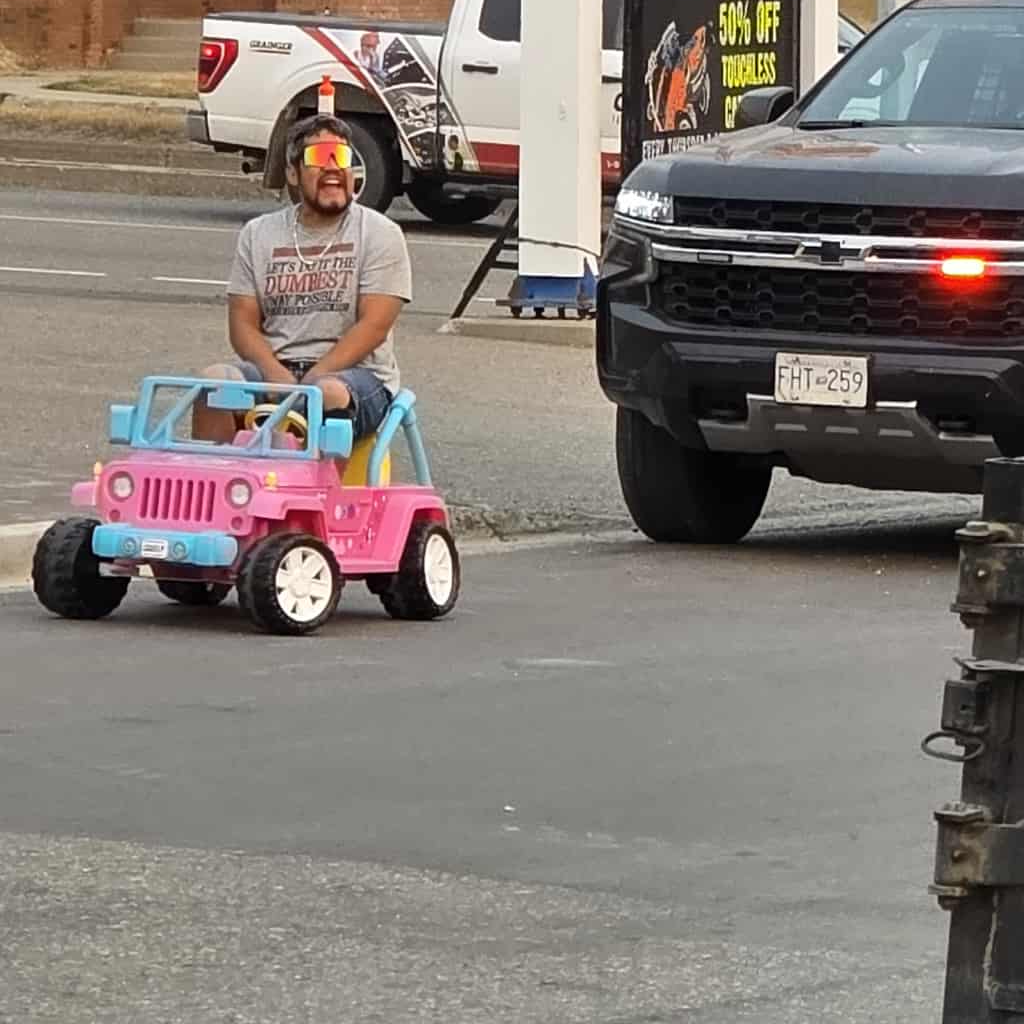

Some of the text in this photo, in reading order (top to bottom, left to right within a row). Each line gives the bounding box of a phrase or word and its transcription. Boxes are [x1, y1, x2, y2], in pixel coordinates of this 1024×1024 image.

[719, 0, 781, 47] 50% OFF
[721, 51, 776, 89] TOUCHLESS
[264, 270, 354, 296] DUMBEST
